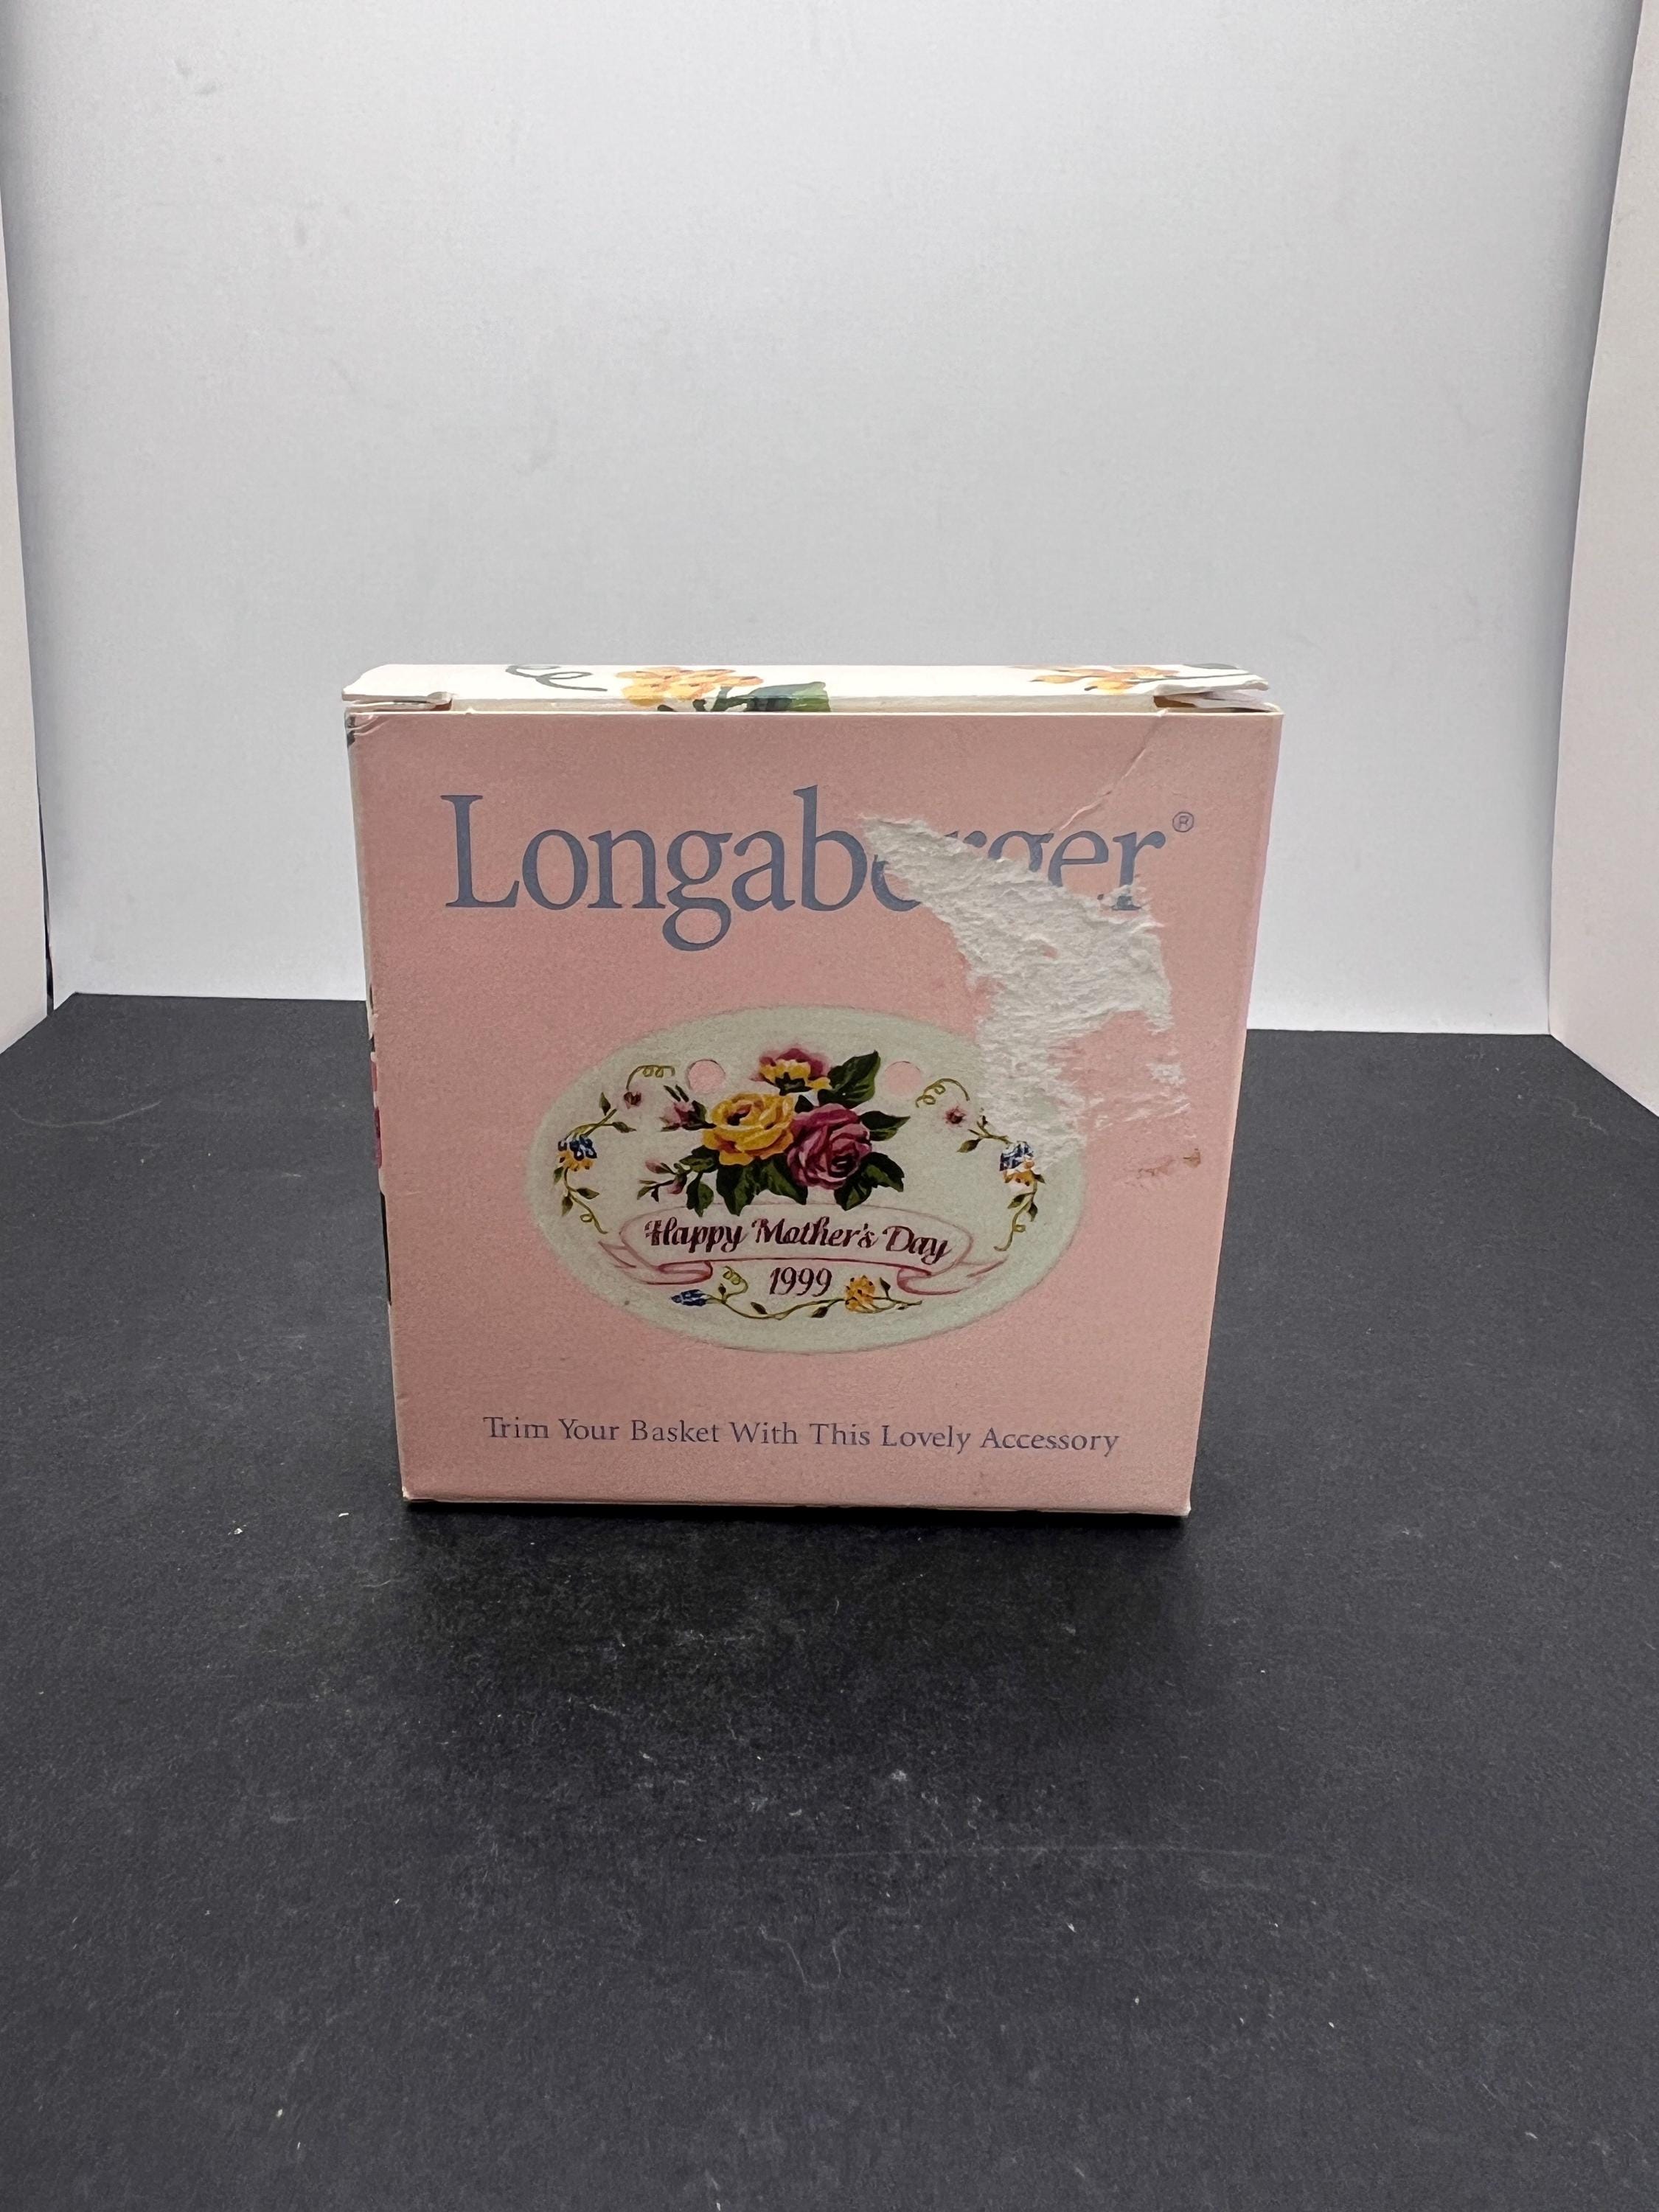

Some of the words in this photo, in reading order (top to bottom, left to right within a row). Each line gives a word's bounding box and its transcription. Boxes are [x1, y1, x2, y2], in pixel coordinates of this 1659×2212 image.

[644, 1217, 748, 1253] Happy
[751, 1216, 879, 1248] Mother's
[883, 1225, 953, 1265] Day
[768, 1267, 833, 1297] 1999
[483, 1416, 549, 1439] Trim
[558, 1418, 619, 1441] Your
[630, 1419, 720, 1443] Basket
[729, 1422, 799, 1444] With
[809, 1423, 871, 1446] This
[882, 1425, 972, 1455] Lovely
[979, 1427, 1119, 1457] Accessory
